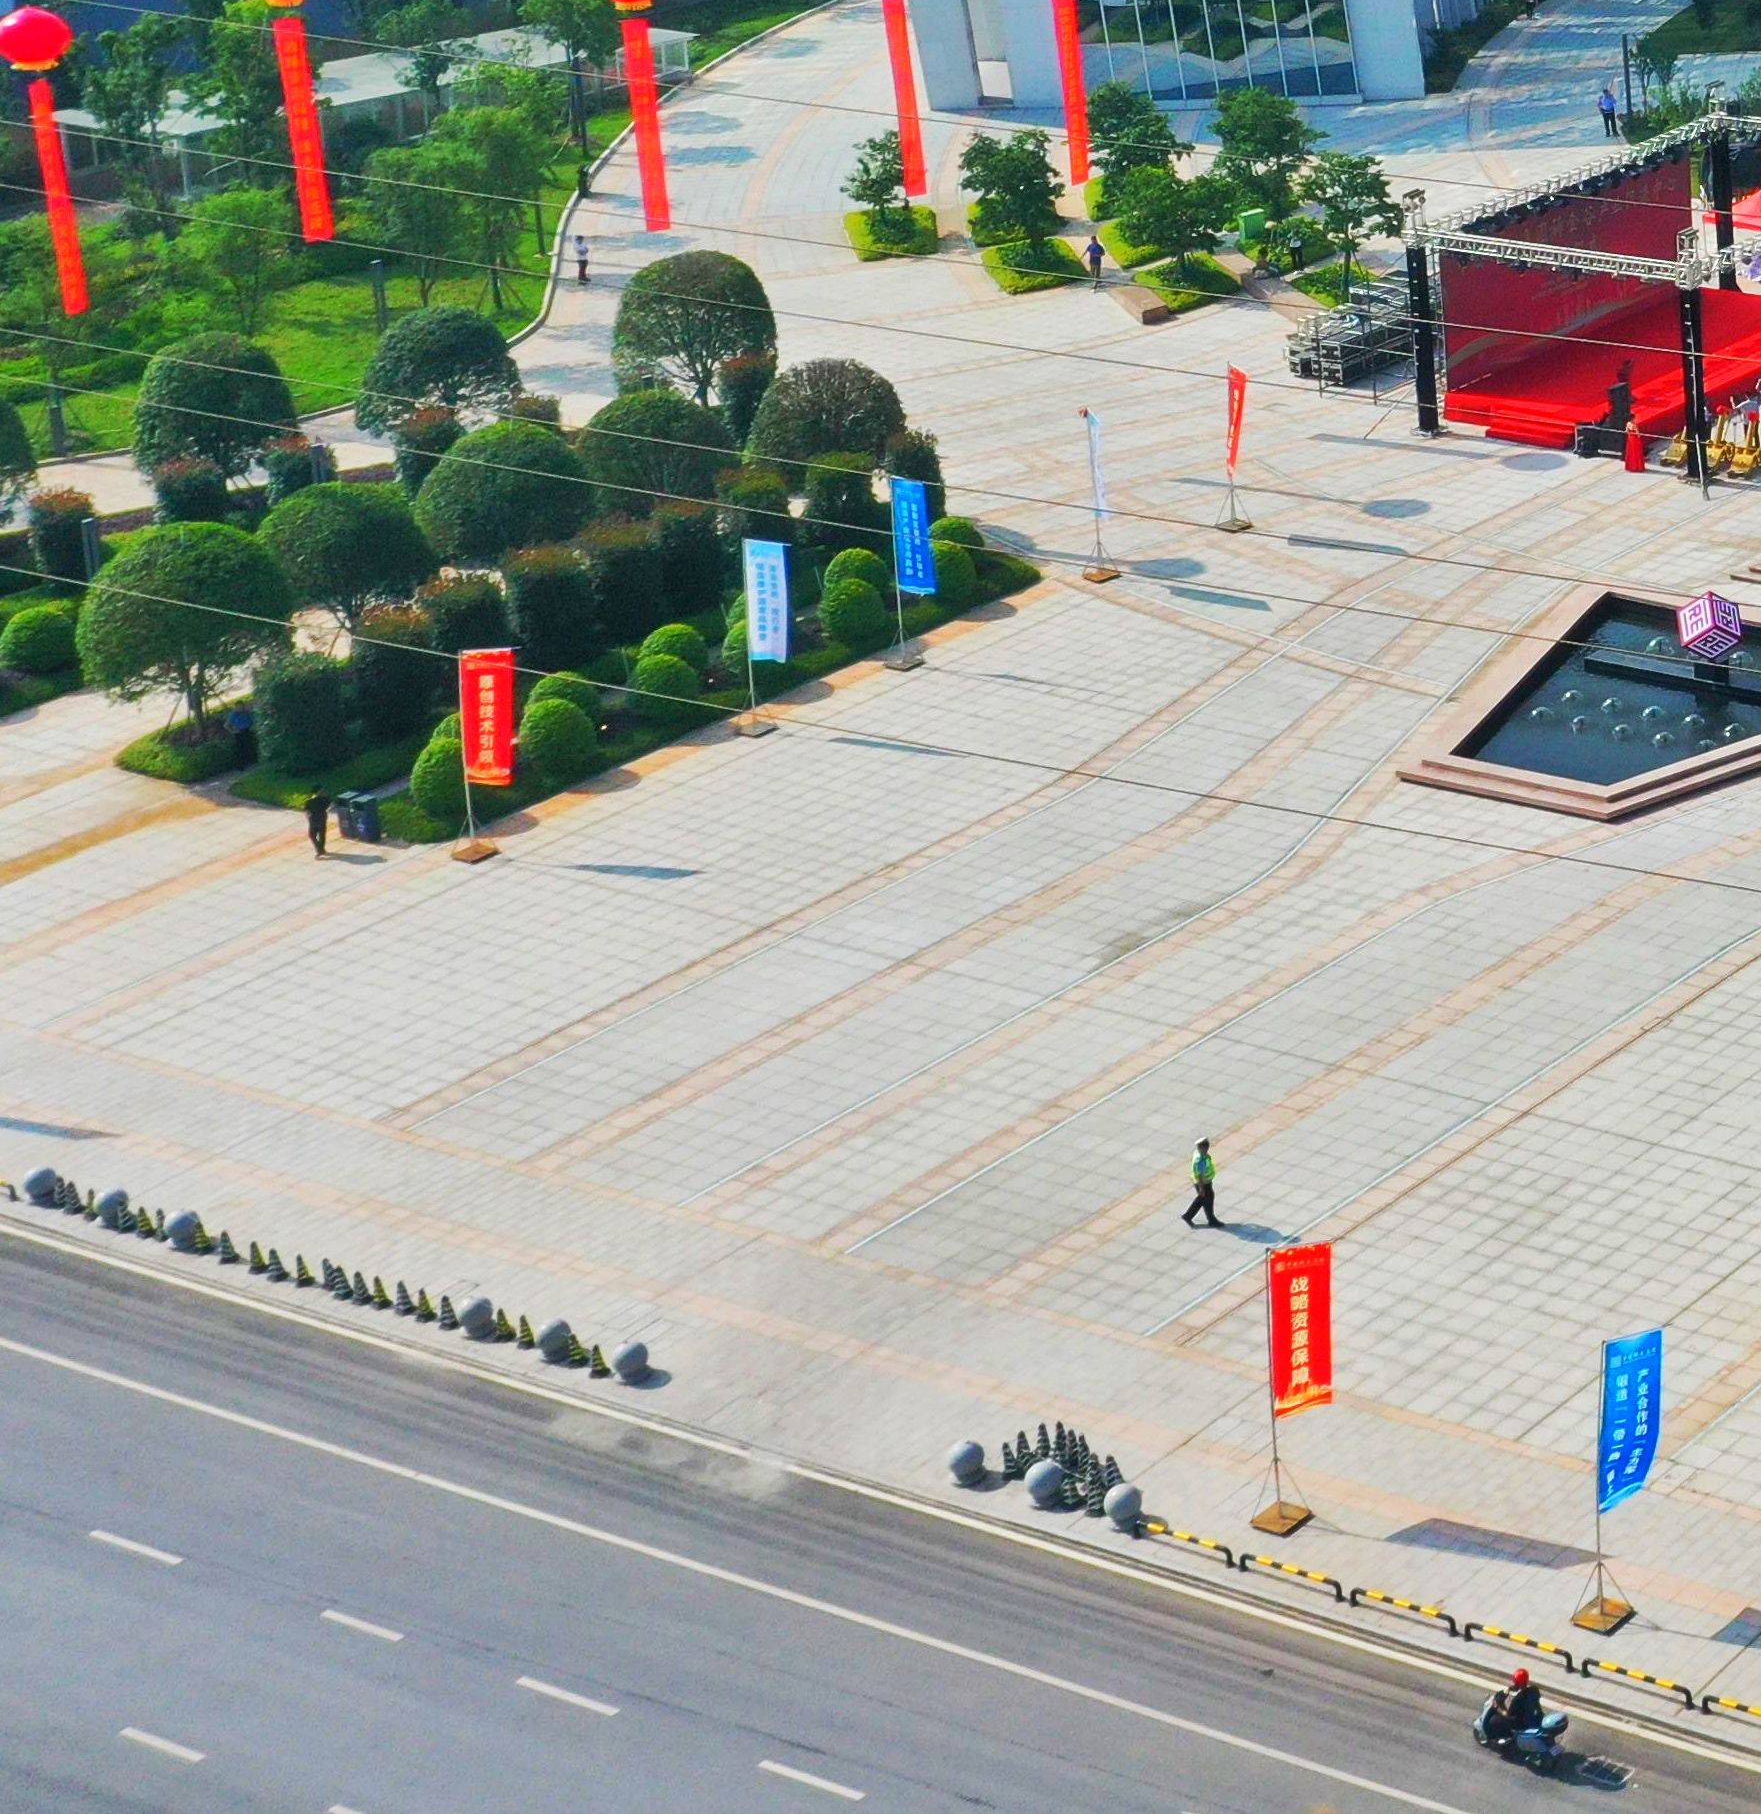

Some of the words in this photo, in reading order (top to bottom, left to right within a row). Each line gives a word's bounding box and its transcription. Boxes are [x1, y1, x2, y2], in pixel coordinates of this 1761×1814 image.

[1289, 1276, 1310, 1386] 战略资源保障
